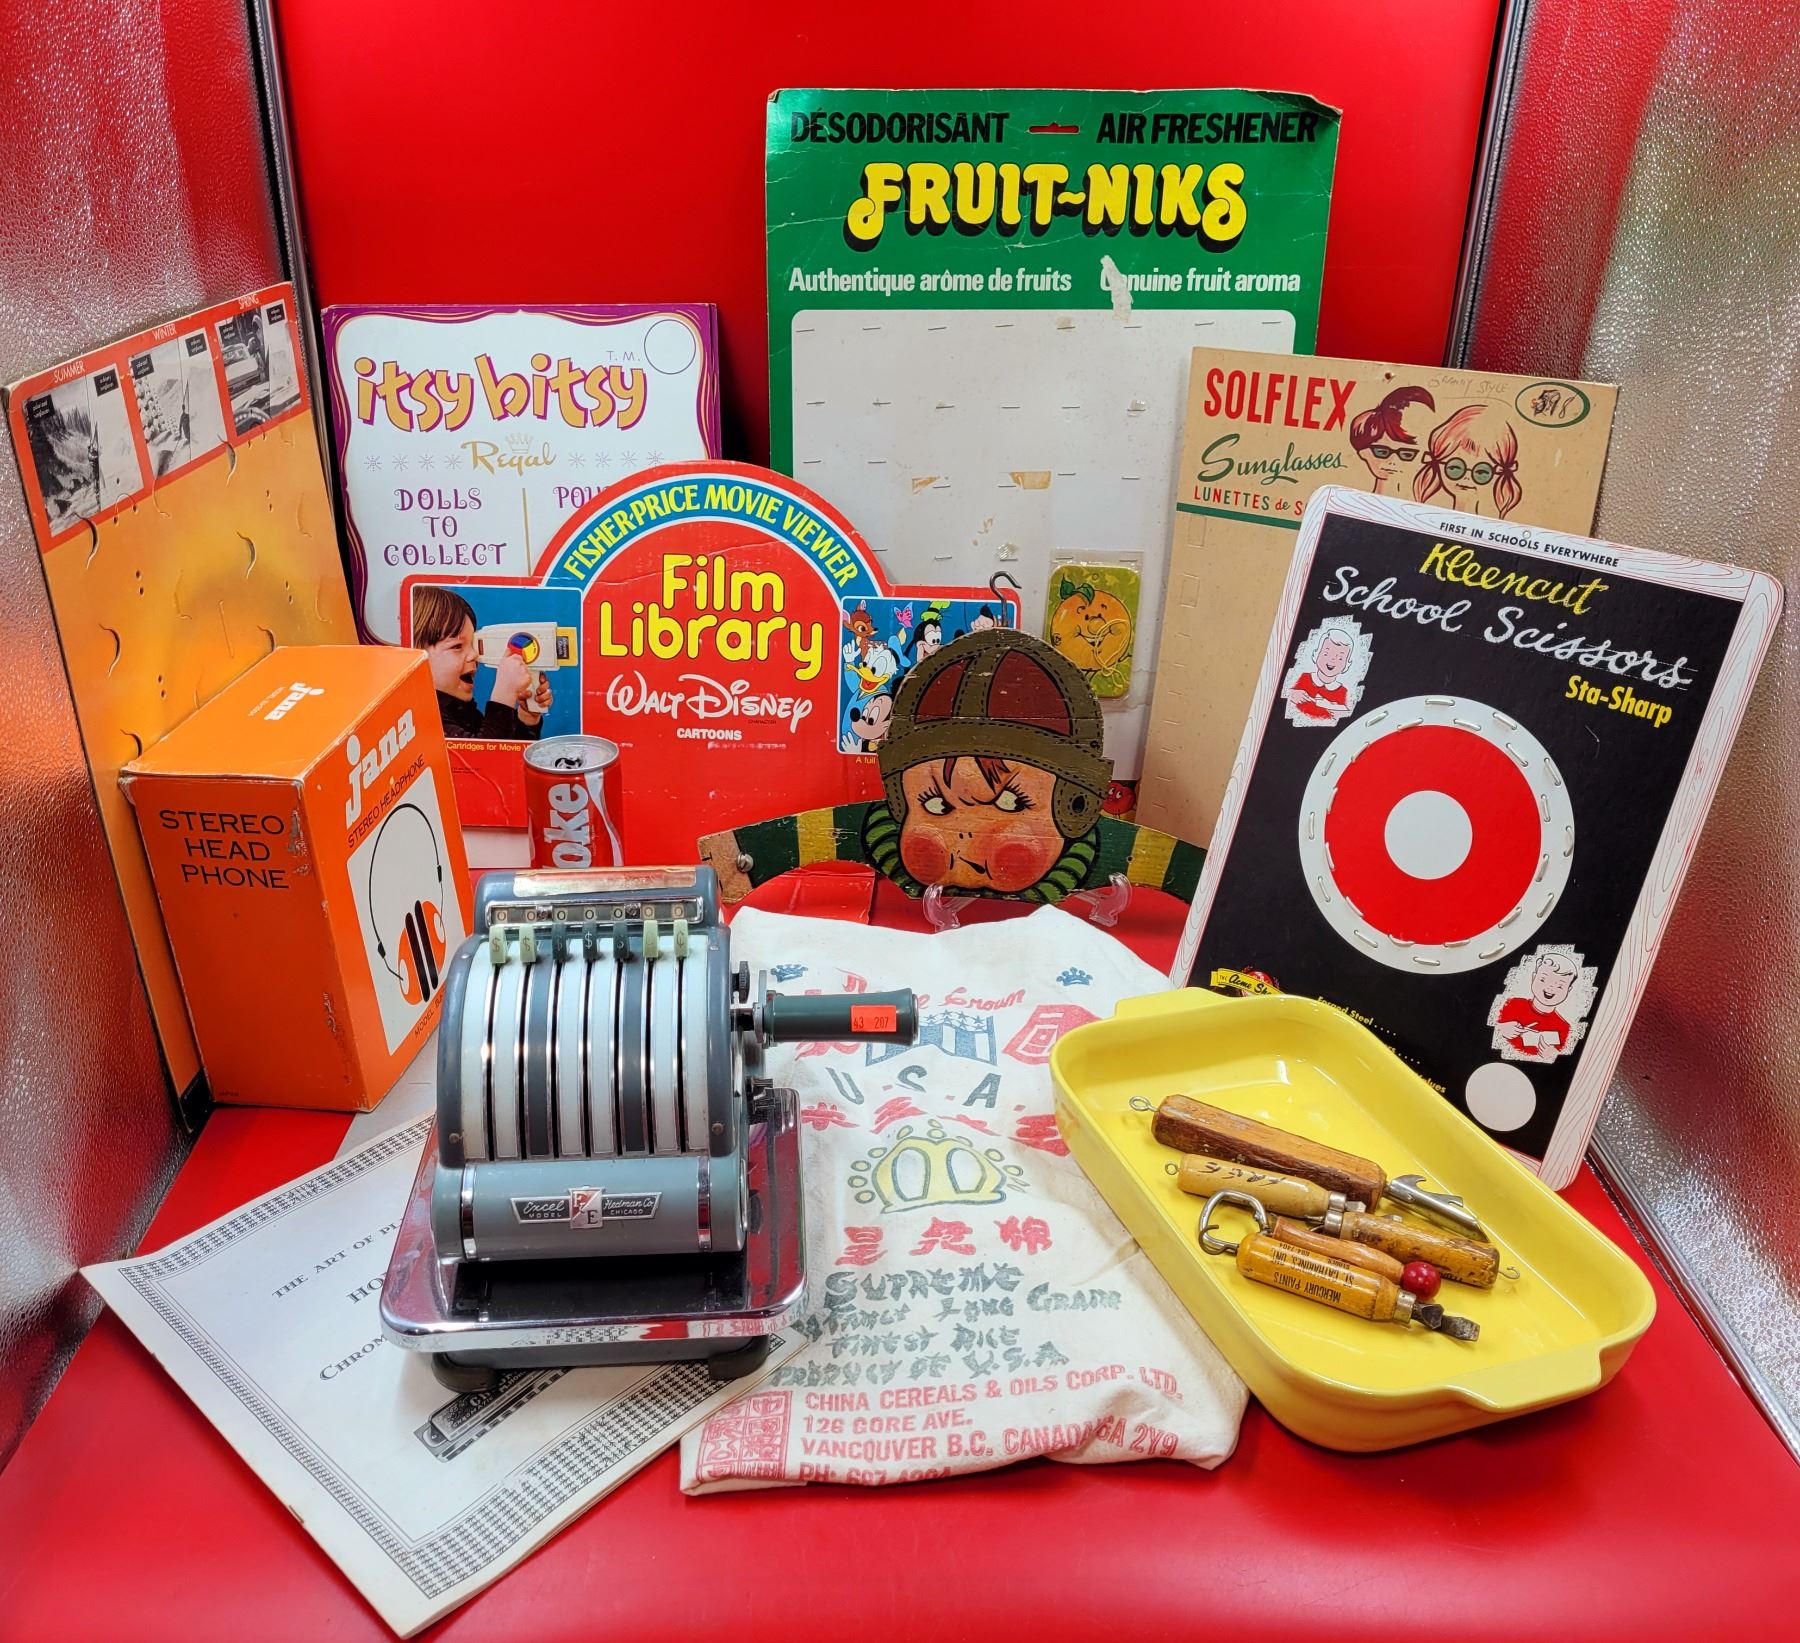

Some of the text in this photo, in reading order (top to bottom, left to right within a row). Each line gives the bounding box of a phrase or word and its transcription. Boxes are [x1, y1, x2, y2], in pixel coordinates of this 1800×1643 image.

[791, 107, 1010, 144] DÉSODORISANT
[1097, 112, 1318, 143] AIR FRESHENER
[789, 267, 1072, 296] Authentique arôme de fruits
[1101, 266, 1301, 292] nuine fruit aroma
[152, 323, 177, 341] WINTER
[53, 360, 86, 383] SUMMER
[354, 352, 648, 433] itsy bitsy
[1204, 367, 1357, 432] SOLFLEX
[1197, 433, 1348, 486] Sunglasses
[393, 487, 483, 511] DOLLS
[1193, 485, 1271, 512] LUNETTES
[1274, 498, 1292, 511] de
[422, 515, 458, 538] TO
[563, 484, 859, 588] FISHER-PRICE MOVIE VIEWER
[383, 542, 508, 566] COLLECT
[1440, 522, 1620, 568] FIRST IN SCHOOLS EVERYWHERE
[662, 553, 785, 613] Film
[1419, 543, 1608, 615] Kleencut
[600, 601, 824, 681] Library
[1323, 565, 1694, 689] School Scissors
[1565, 675, 1673, 727] Sta-Sharp
[446, 741, 485, 752] Cartridges
[487, 743, 497, 751] for
[499, 743, 521, 752] Movie
[676, 727, 742, 741] CARTOONS
[855, 756, 876, 764] A full
[347, 753, 425, 849] STEREO HEADPHONE
[159, 809, 285, 835] STEREO
[543, 783, 592, 869] oke
[184, 838, 271, 862] HEAD
[181, 863, 290, 889] PHONE
[1229, 974, 1252, 989] Acme
[1254, 982, 1272, 995] Sh
[874, 1016, 889, 1029] 207
[1349, 1009, 1374, 1026] Steel
[523, 1199, 565, 1214] Excel
[610, 1208, 644, 1216] CHICAGO
[271, 1218, 405, 1299] THE ART OF PL
[346, 1271, 388, 1304] HO
[1273, 1271, 1342, 1304] MERCURY PAINTS
[319, 1333, 389, 1381] CHROM
[805, 1364, 1184, 1412] CHINA CEREALS & OILS CORP. LTD.
[803, 1415, 844, 1434] 126
[923, 1408, 974, 1428] AVE.
[947, 1430, 994, 1457] B.C.
[1130, 1422, 1180, 1458] 2Y9
